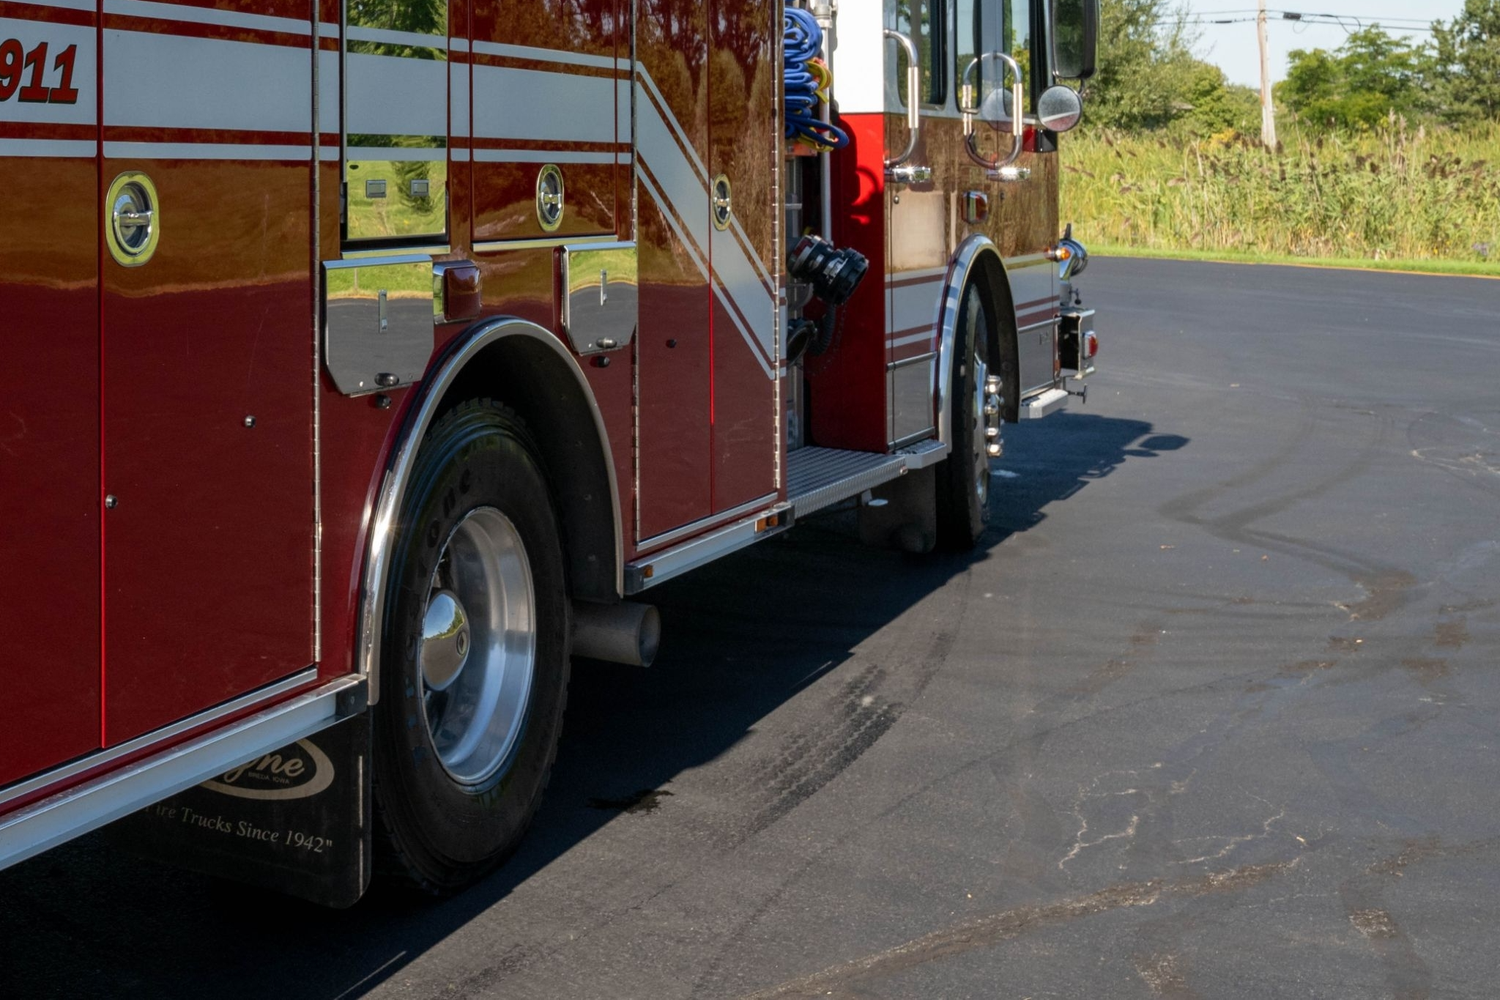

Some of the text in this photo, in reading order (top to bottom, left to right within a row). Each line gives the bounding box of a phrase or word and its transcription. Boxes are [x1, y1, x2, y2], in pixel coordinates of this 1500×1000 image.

[181, 806, 233, 833] Trucks
[235, 820, 280, 842] Since
[285, 830, 333, 853] 1942"
